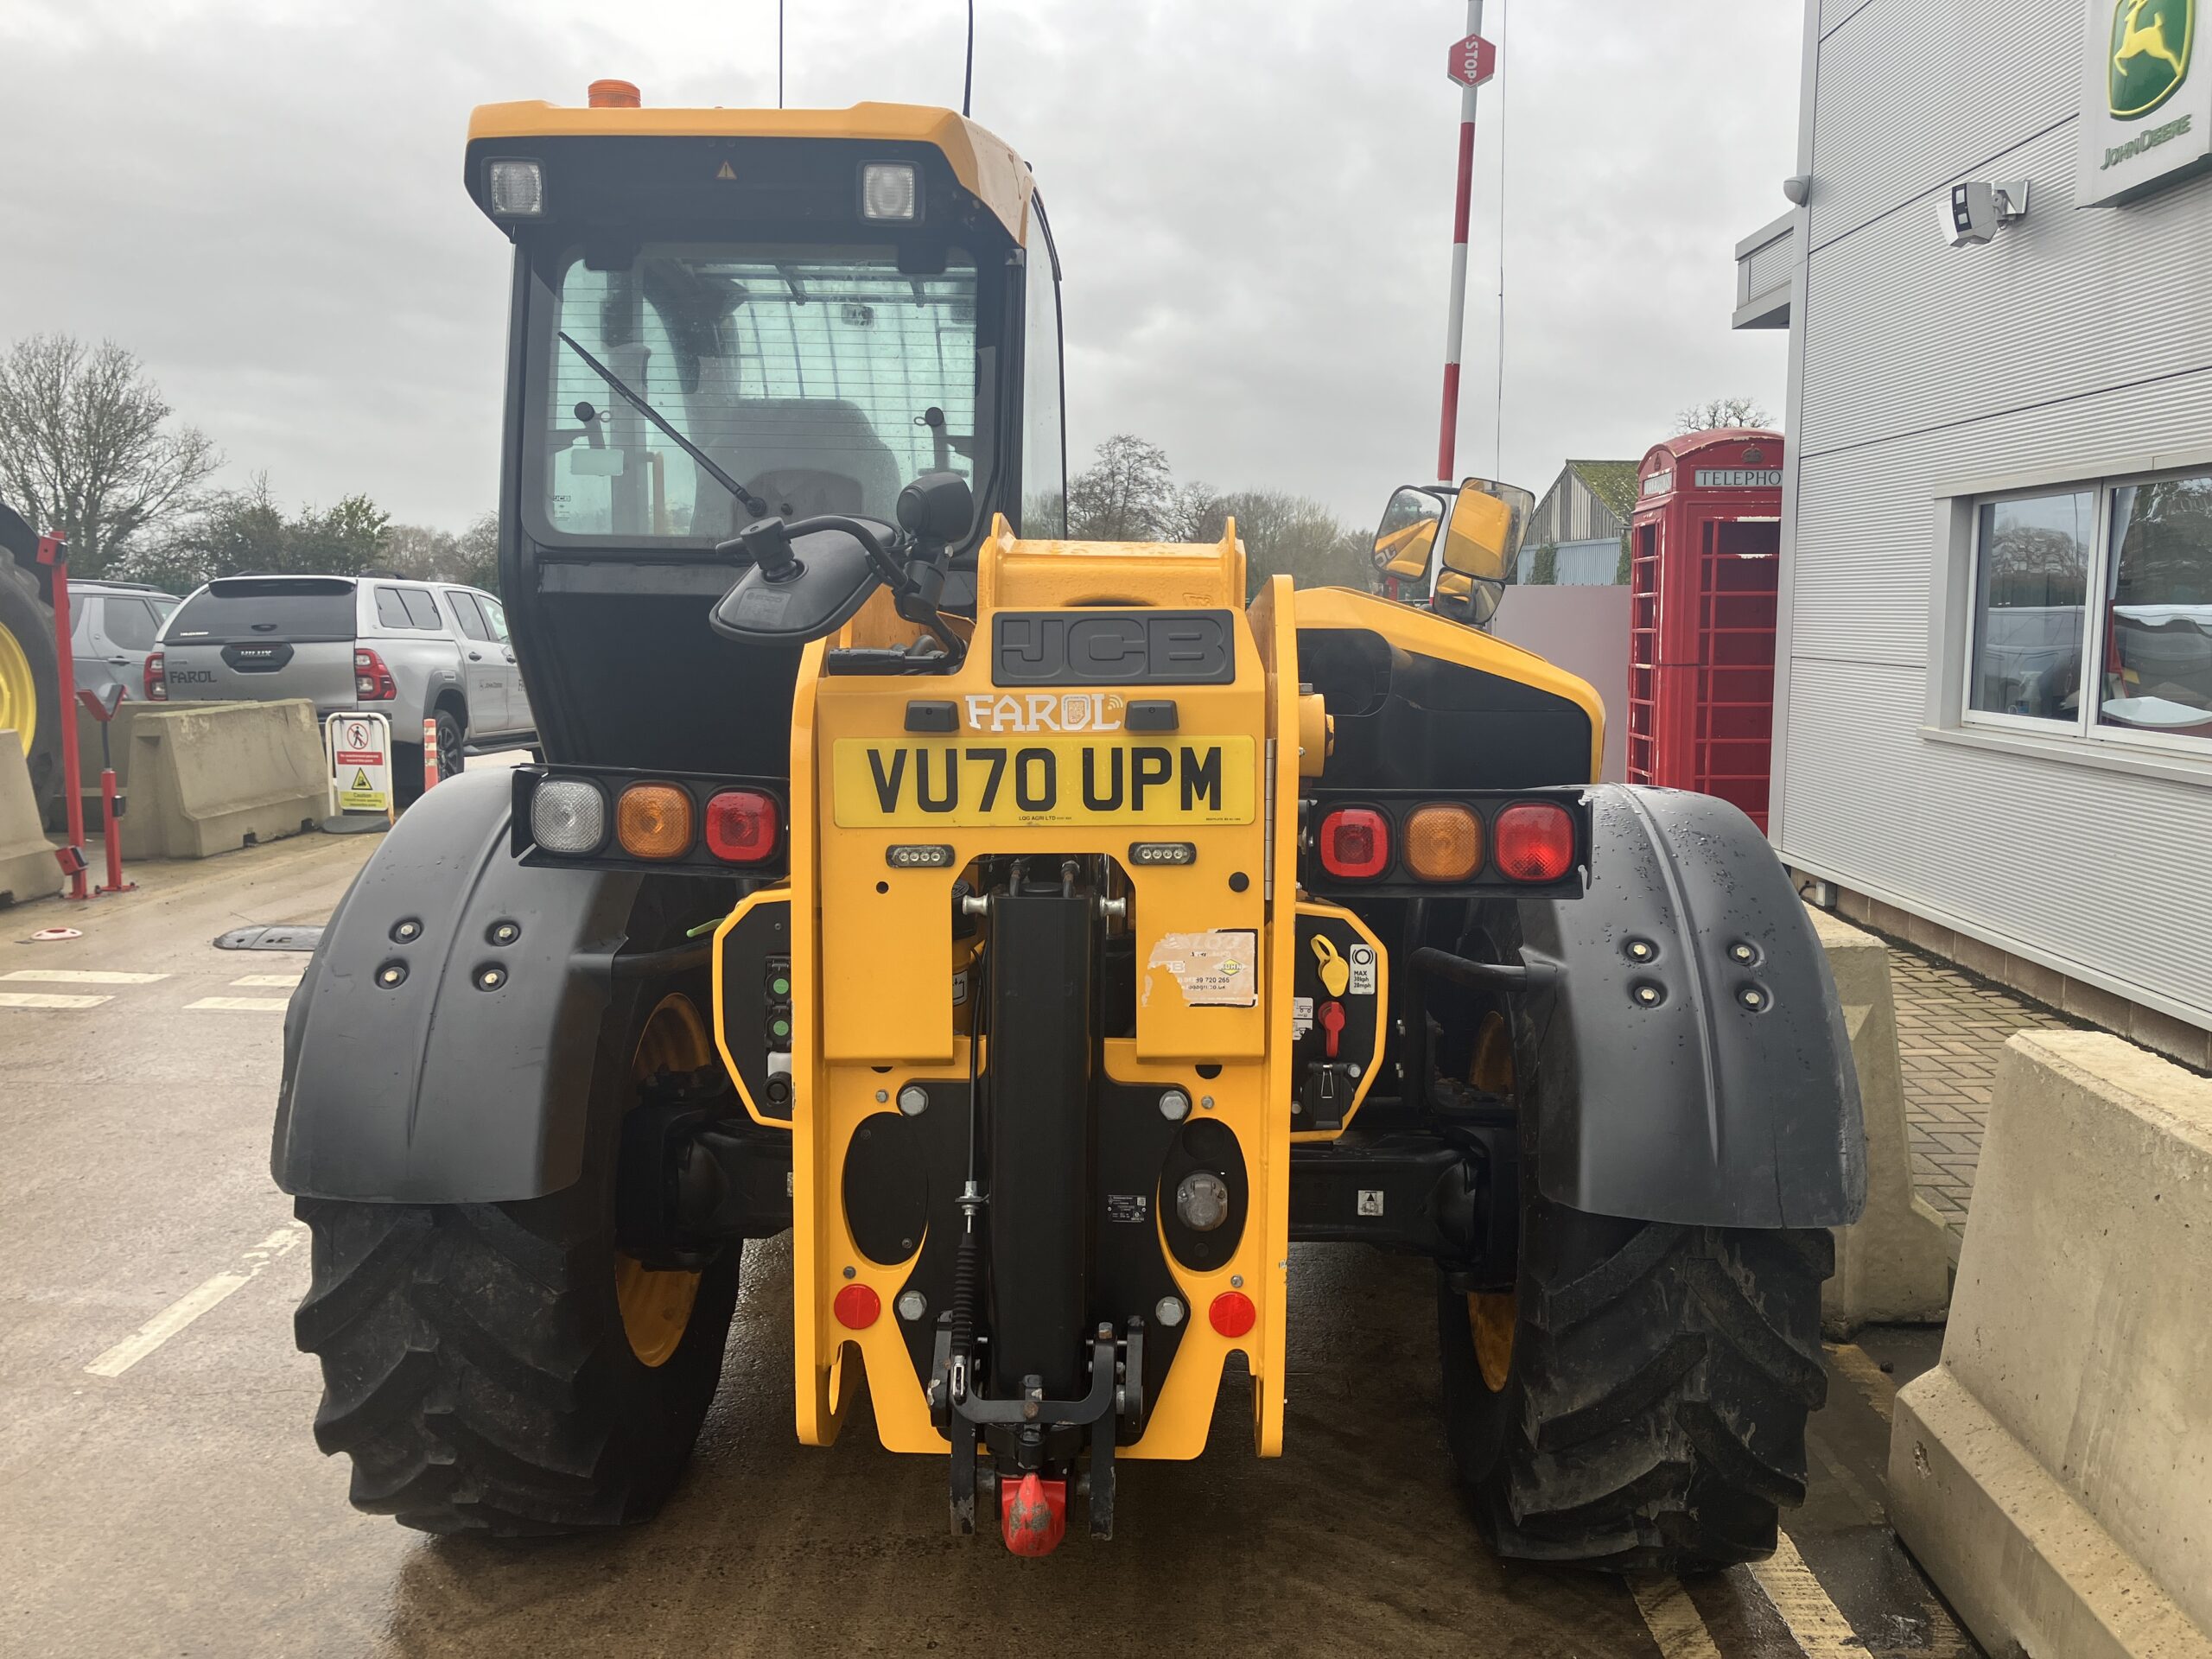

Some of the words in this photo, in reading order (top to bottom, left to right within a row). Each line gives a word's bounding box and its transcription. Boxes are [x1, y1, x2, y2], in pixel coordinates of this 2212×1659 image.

[1465, 41, 1478, 79] STOP
[2100, 138, 2141, 170] JOHN
[2140, 114, 2192, 152] DEERE
[1700, 471, 1782, 486] TELEPHO
[1001, 618, 1227, 678] JCB
[168, 671, 217, 683] FAROL
[965, 694, 1121, 732] FAROL
[867, 747, 1057, 813] VU70
[1082, 747, 1222, 811] UPM
